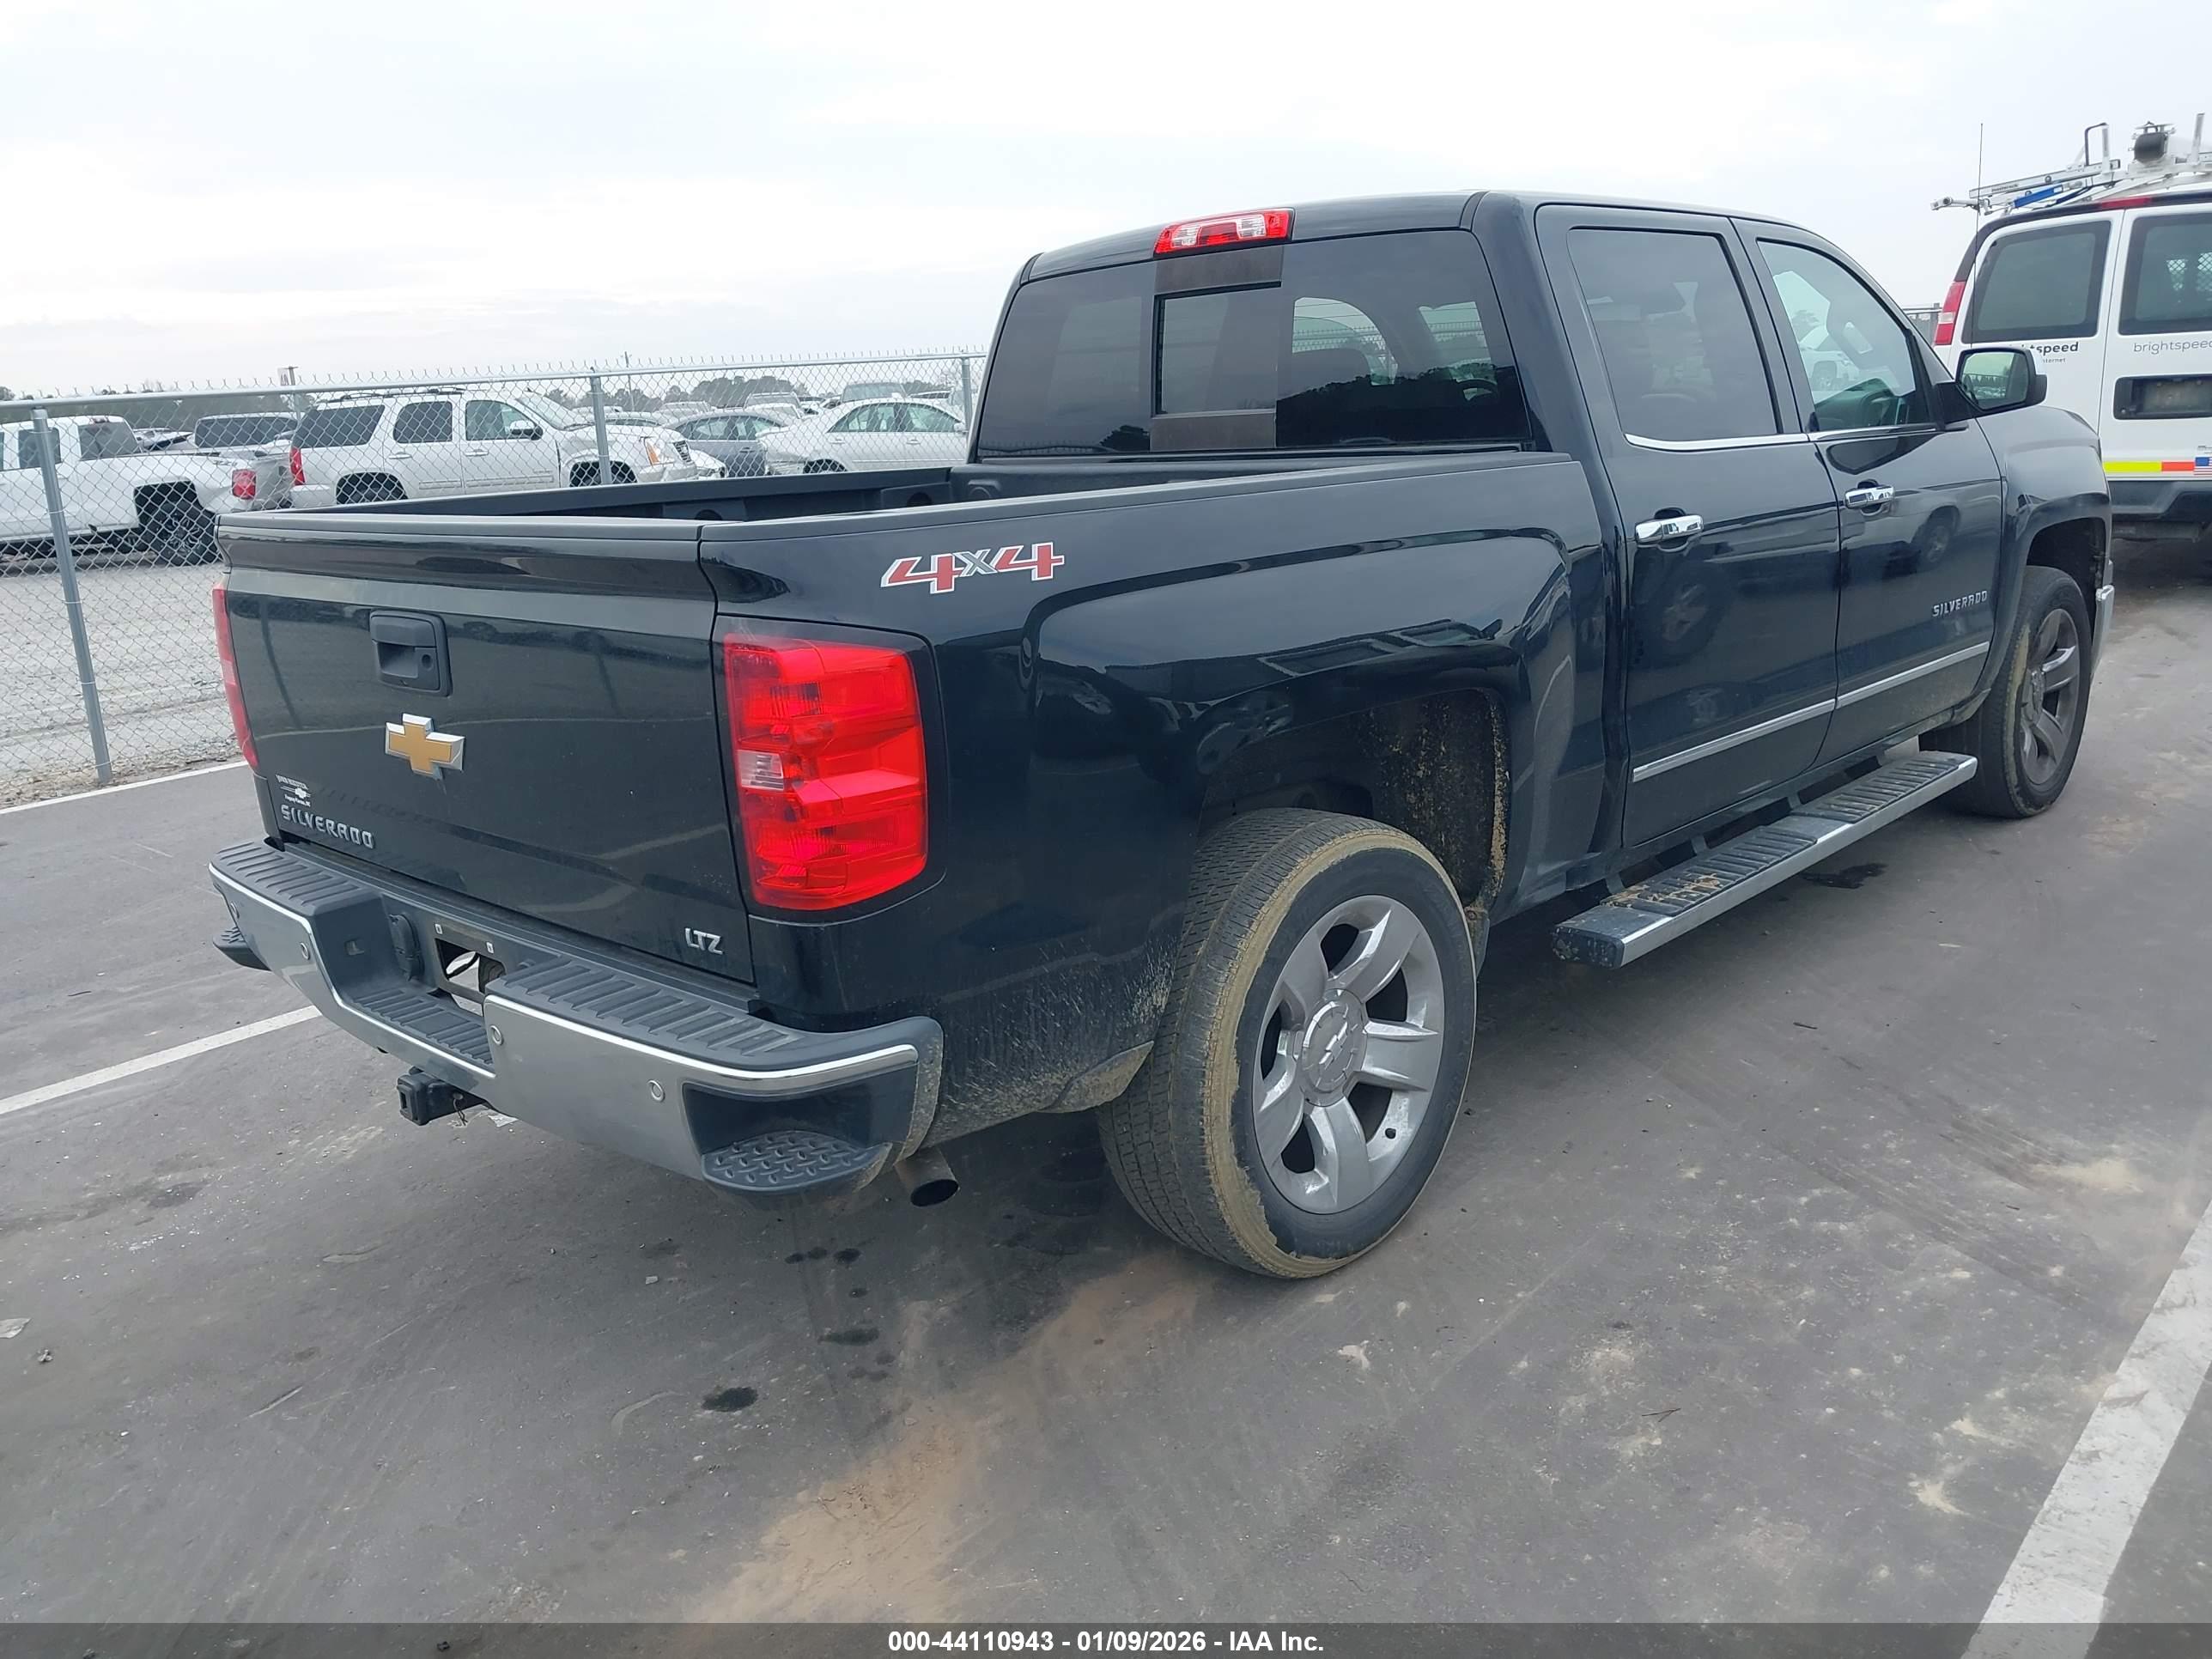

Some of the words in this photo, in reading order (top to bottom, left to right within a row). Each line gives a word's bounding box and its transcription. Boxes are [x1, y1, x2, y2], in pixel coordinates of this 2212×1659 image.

[1932, 590, 1988, 617] SILVERADO
[281, 804, 374, 848] SILVERADO
[684, 927, 724, 955] LTZ
